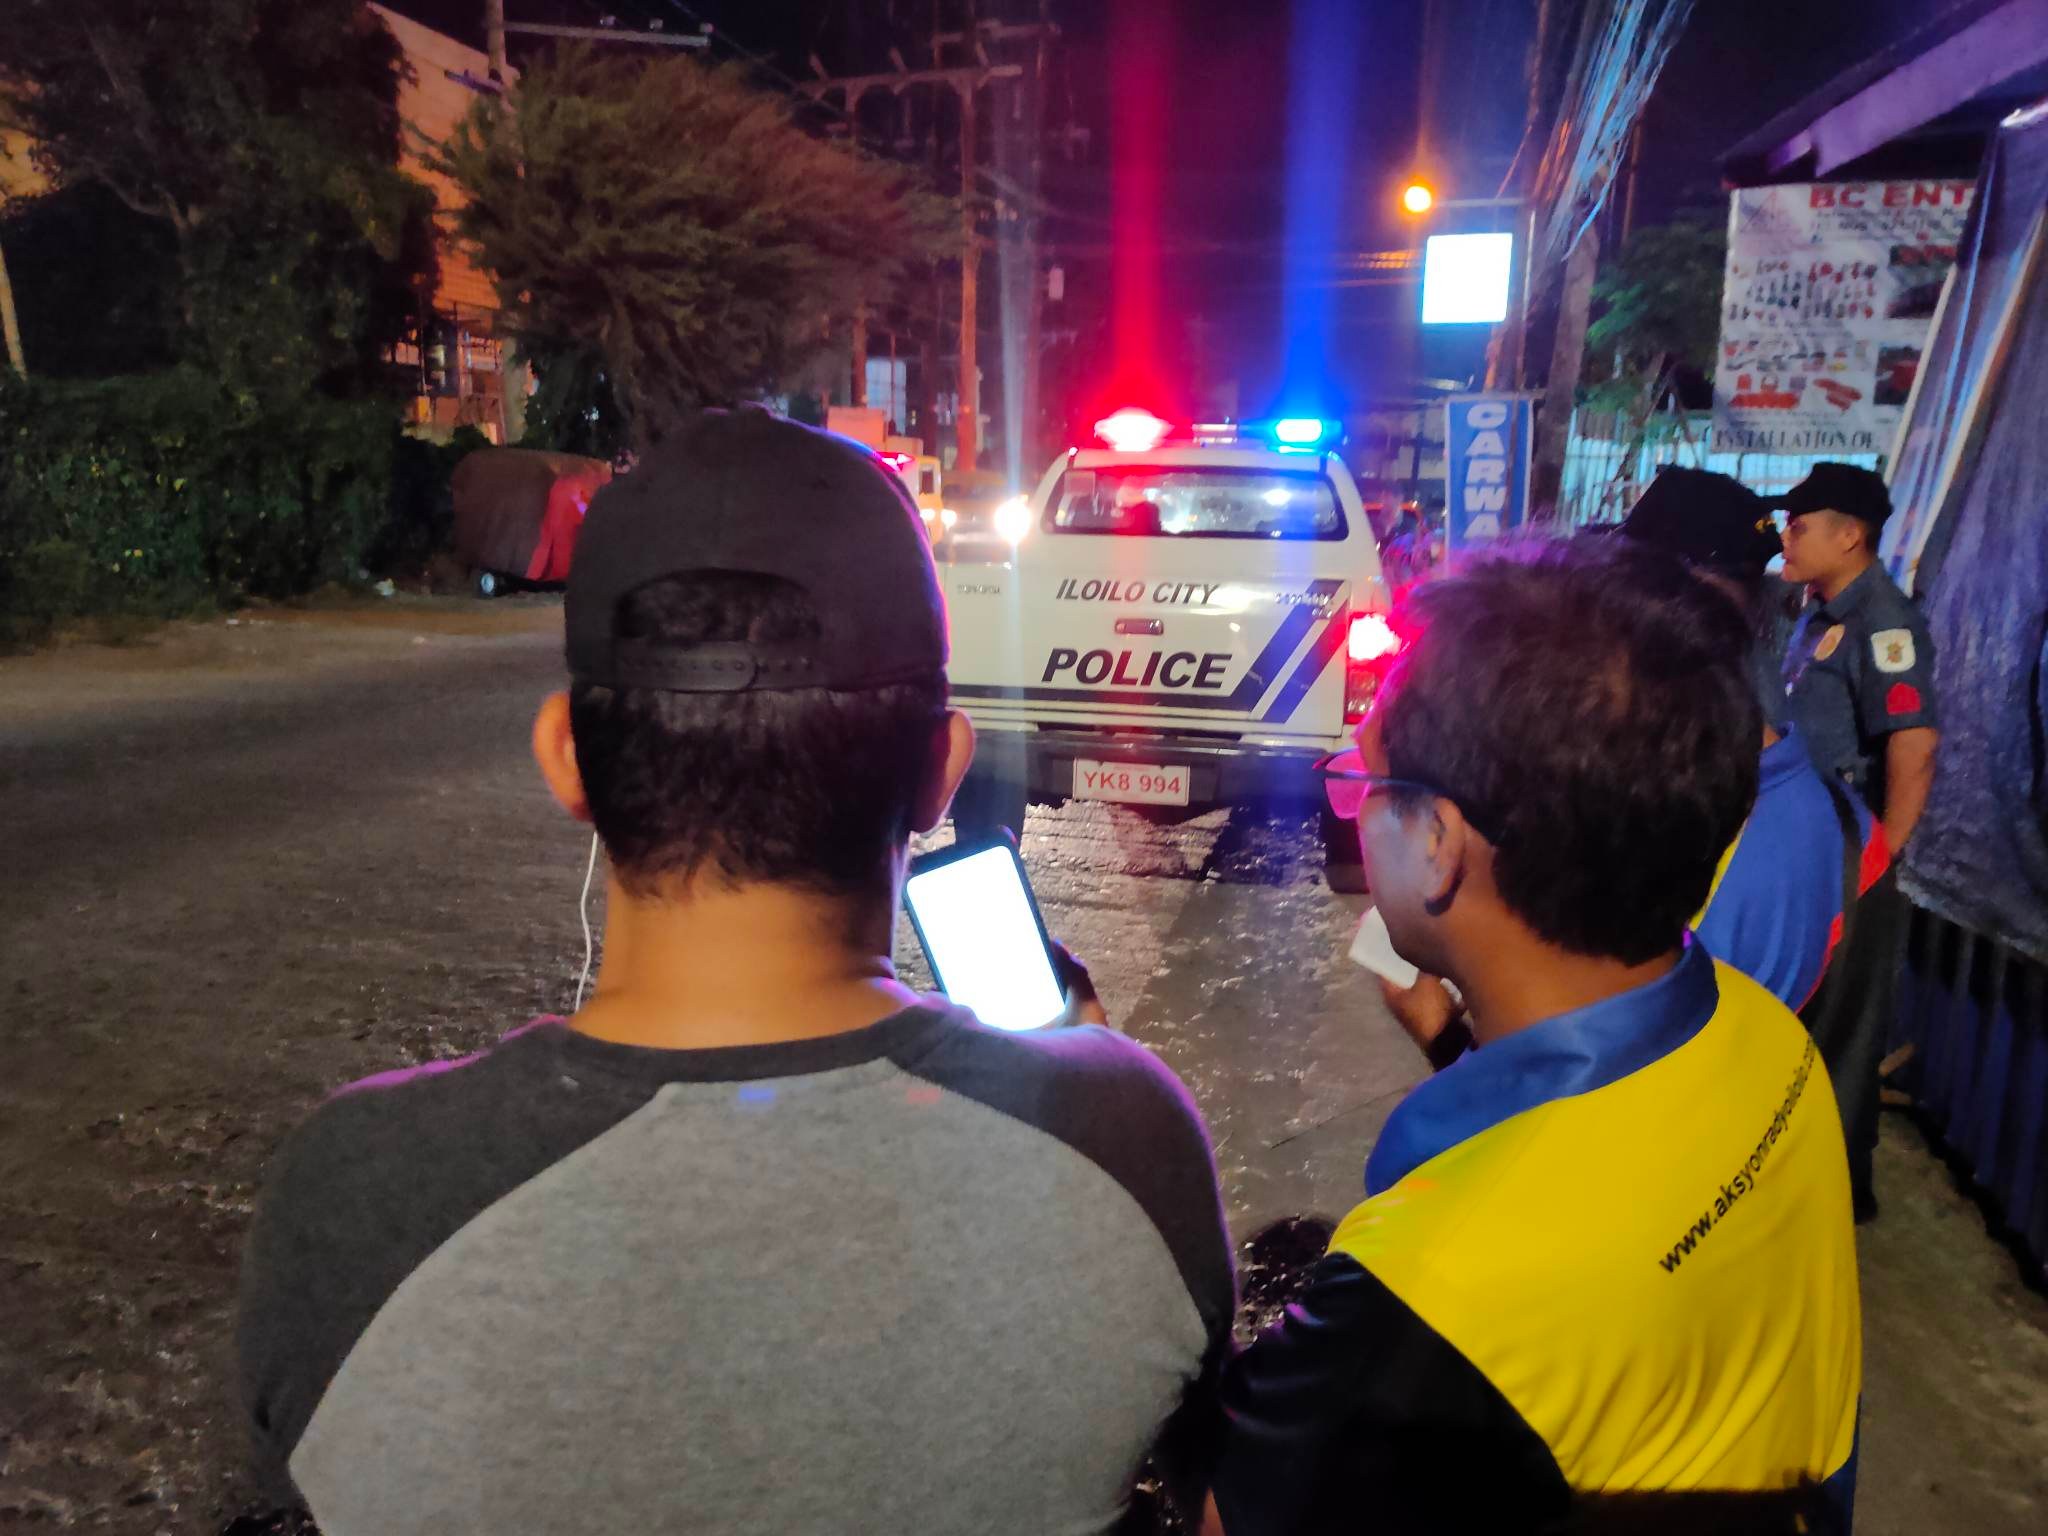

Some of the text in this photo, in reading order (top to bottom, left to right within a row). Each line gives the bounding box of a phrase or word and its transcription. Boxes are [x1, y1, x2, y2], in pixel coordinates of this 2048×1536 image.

[1056, 578, 1220, 606] ILOILO CITY
[1041, 648, 1232, 689] POLICE
[1139, 774, 1180, 794] 994
